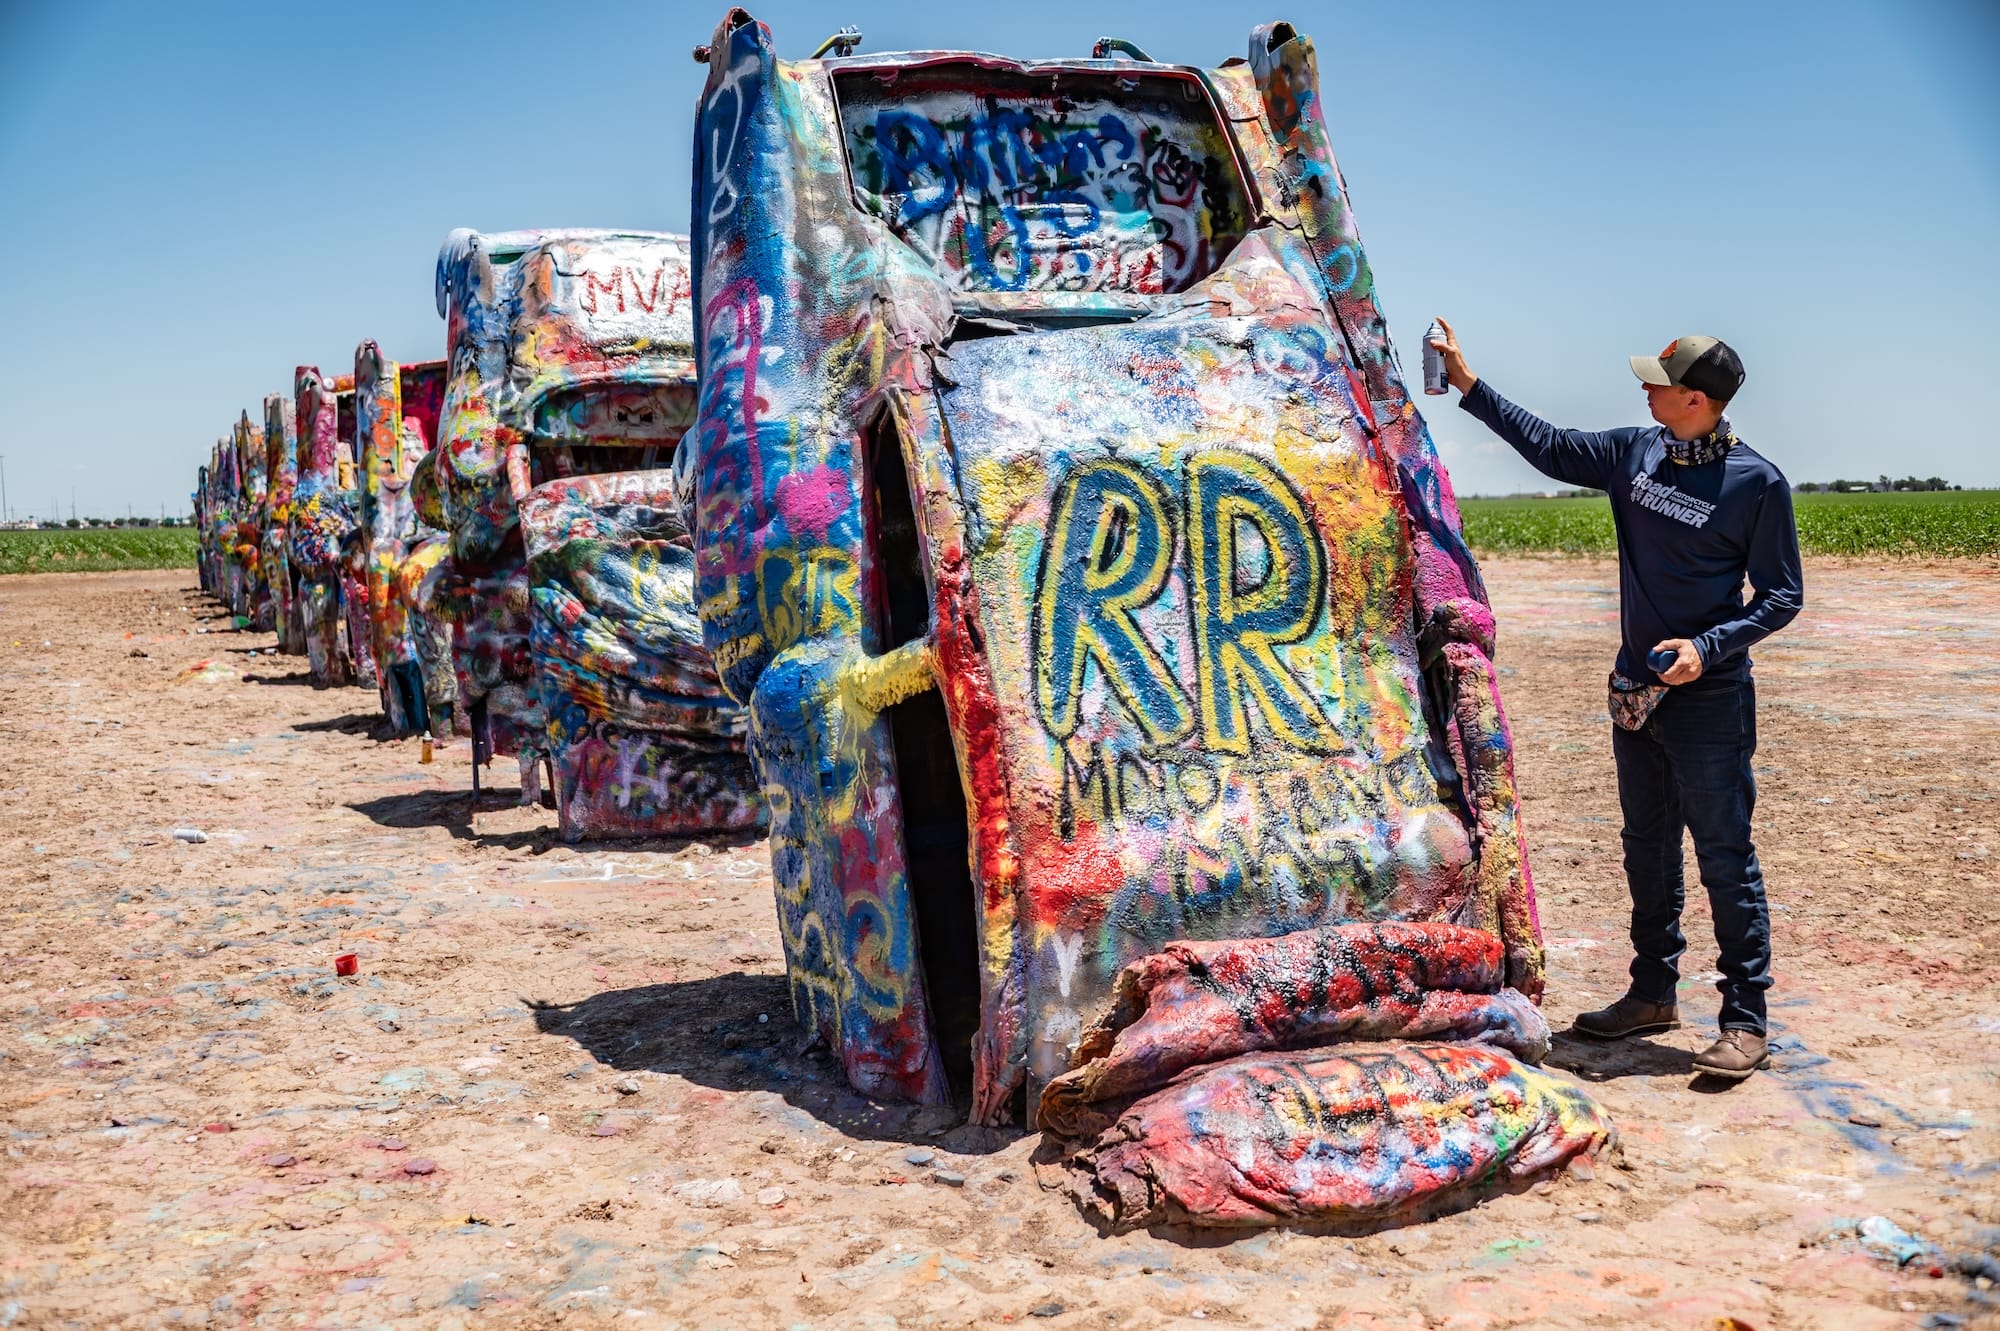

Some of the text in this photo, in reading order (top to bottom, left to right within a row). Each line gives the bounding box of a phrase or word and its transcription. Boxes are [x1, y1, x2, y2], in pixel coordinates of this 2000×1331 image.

[1631, 471, 1677, 499] Road
[1671, 490, 1717, 512] MOTORCYCLE
[1640, 492, 1709, 528] RUNNER
[1031, 443, 1352, 757] RR
